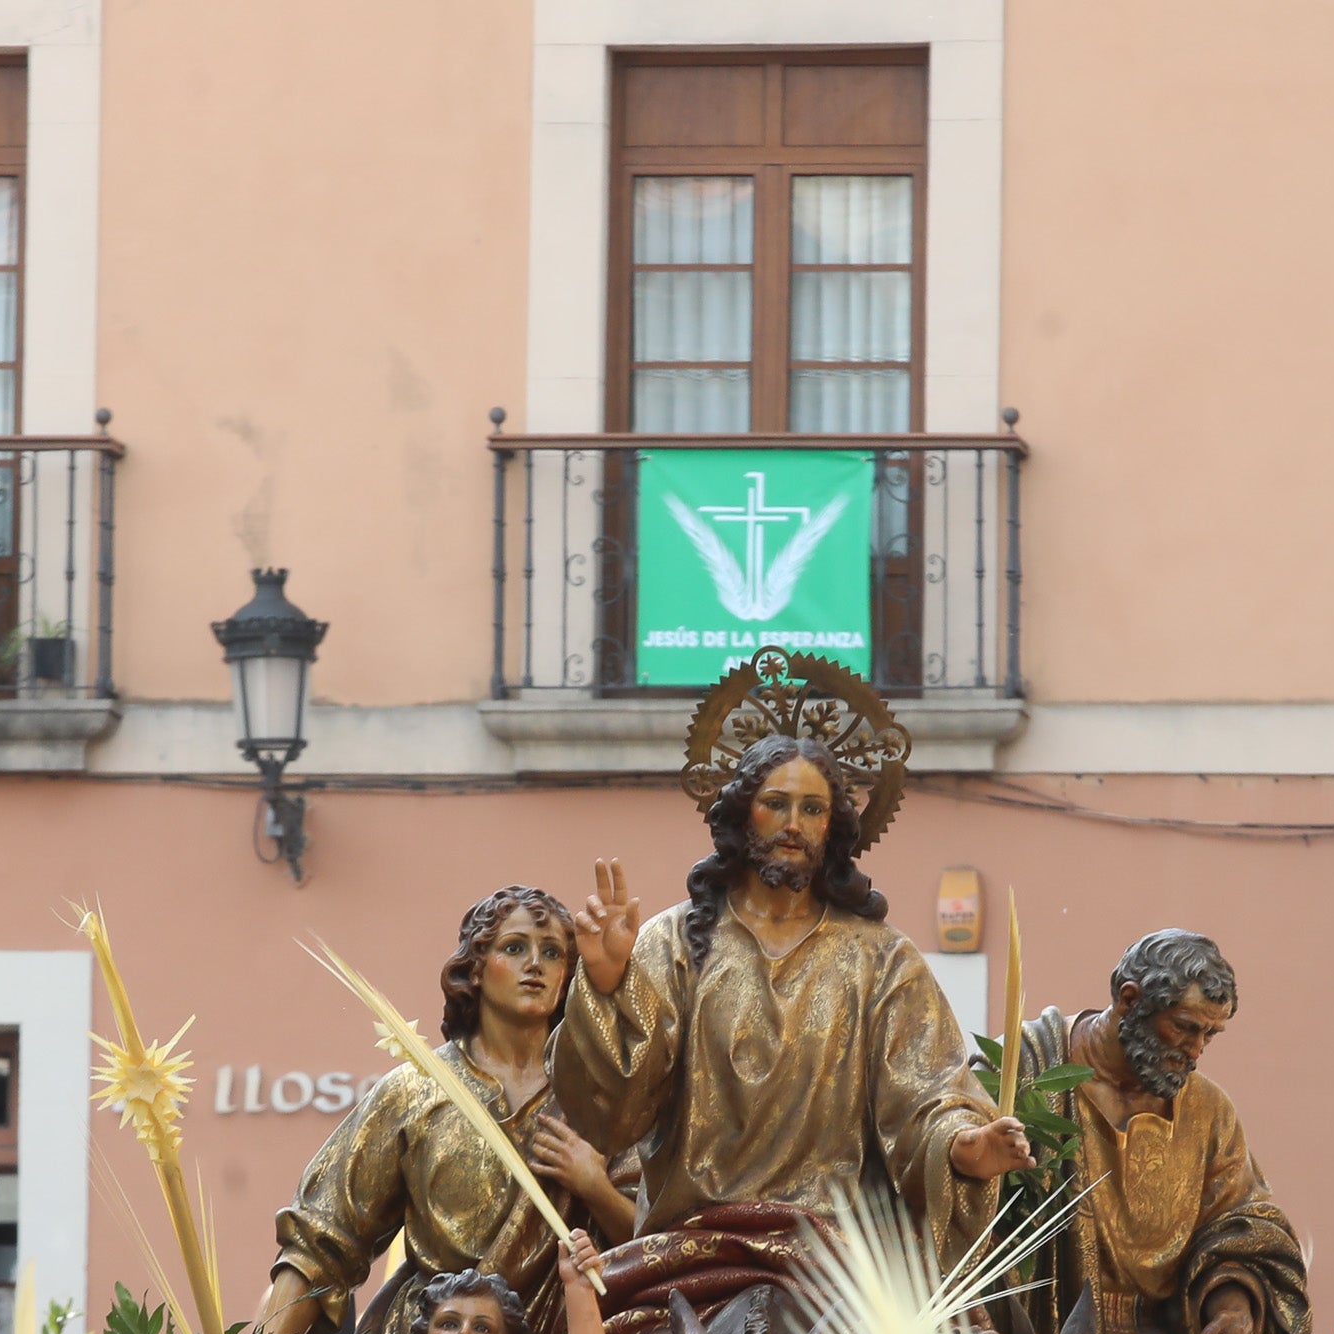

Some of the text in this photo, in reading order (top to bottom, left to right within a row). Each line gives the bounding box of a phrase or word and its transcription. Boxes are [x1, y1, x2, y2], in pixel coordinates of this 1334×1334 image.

[645, 627, 864, 647] JESÚS DE LA ESPERANZA
